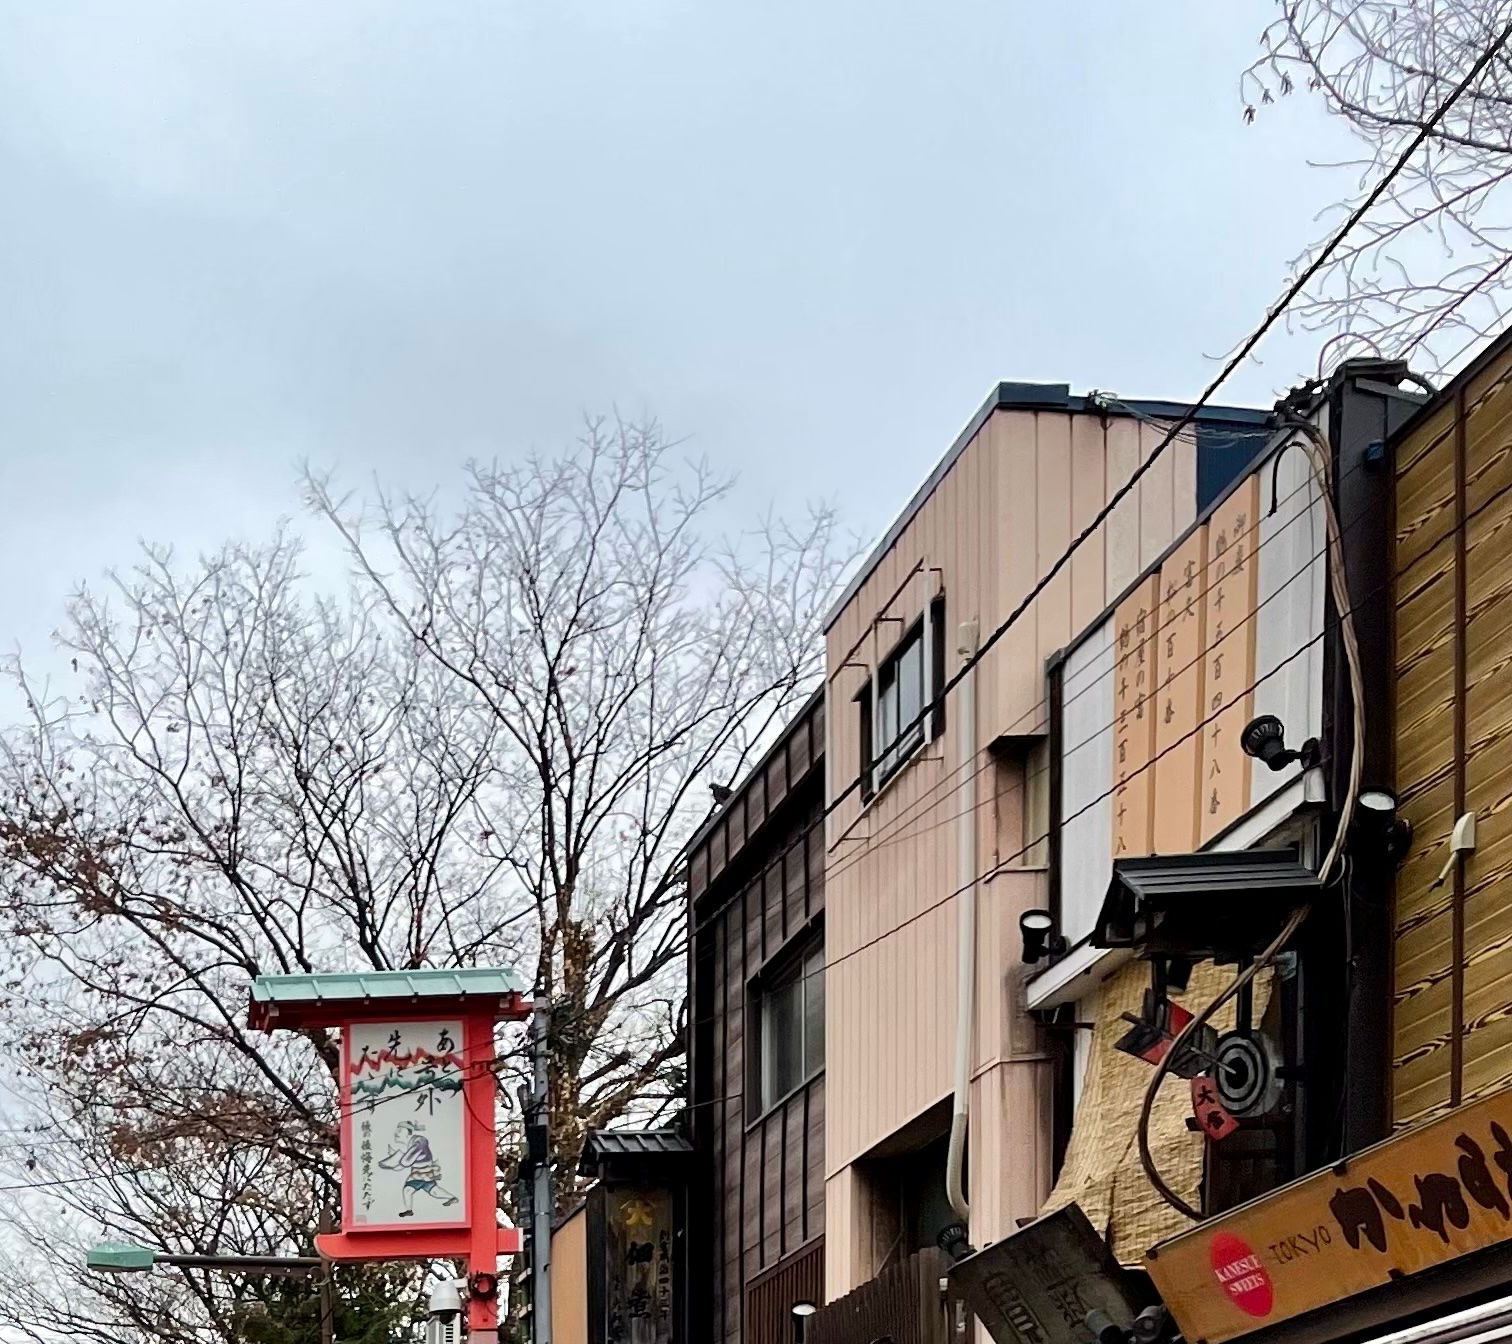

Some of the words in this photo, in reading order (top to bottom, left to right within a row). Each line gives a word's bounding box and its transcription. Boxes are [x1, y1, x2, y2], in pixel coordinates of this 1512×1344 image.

[1268, 1225, 1333, 1266] TOKYO
[1214, 1253, 1261, 1284] KANESUE
[1229, 1274, 1265, 1296] SWEETS
